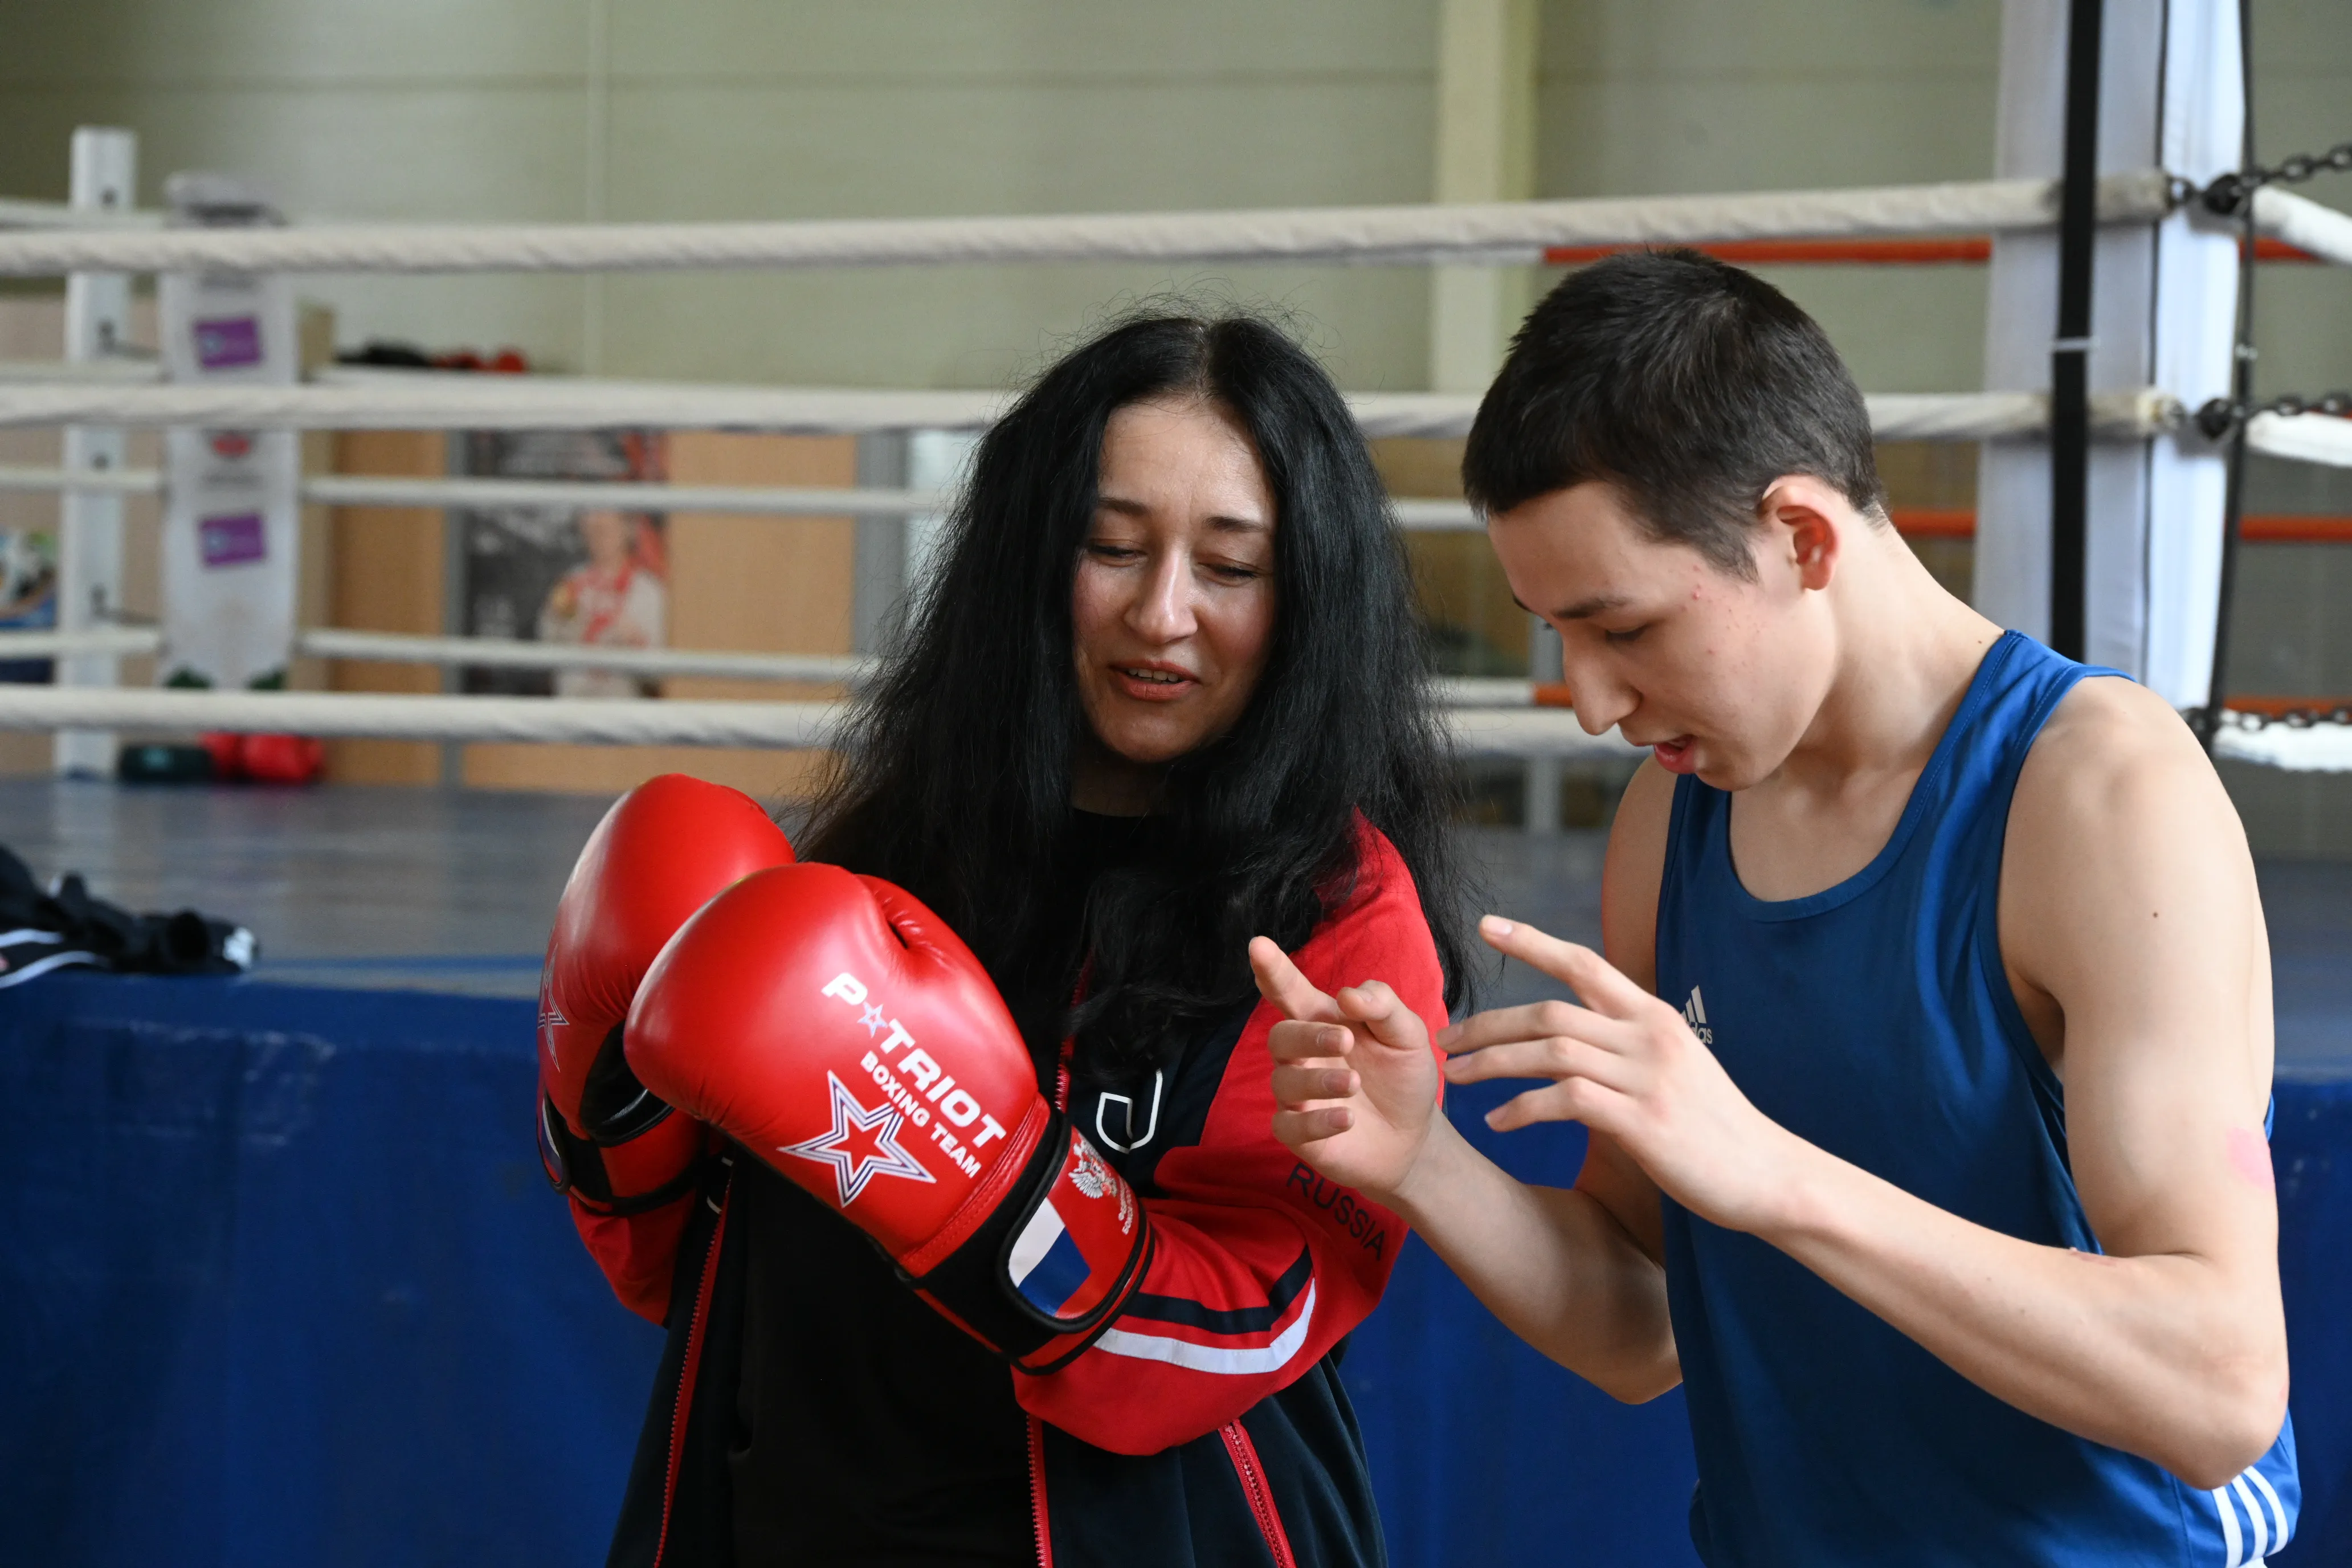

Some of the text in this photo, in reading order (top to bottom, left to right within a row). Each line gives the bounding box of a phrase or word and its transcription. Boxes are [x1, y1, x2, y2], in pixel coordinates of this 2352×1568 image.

[860, 1050, 982, 1179] BOXING TEAM
[1286, 1162, 1385, 1261] RUSSIA
